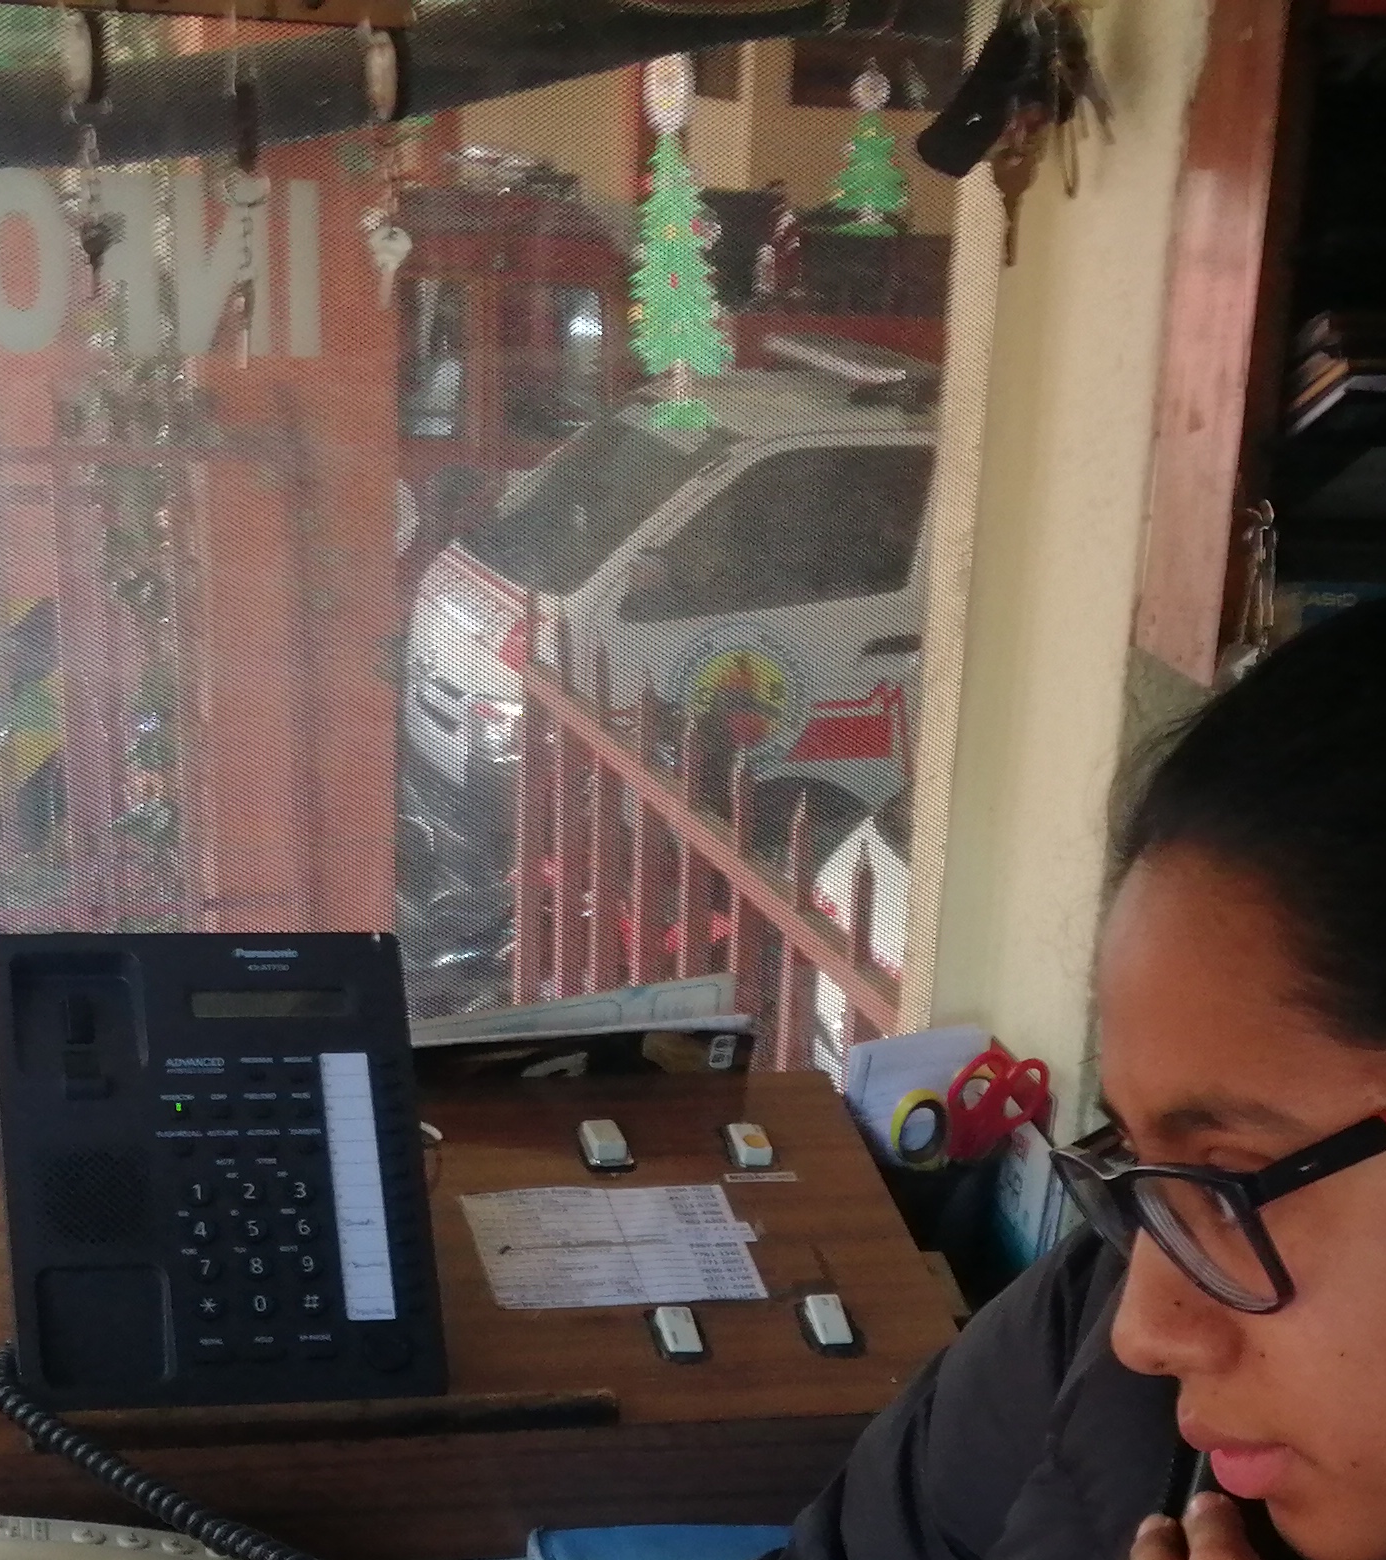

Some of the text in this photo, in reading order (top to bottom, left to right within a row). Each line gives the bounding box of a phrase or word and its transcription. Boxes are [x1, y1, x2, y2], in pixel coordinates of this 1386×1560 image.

[165, 1056, 225, 1069] ADVANCED
[192, 1181, 308, 1201] 1 2 3
[193, 1218, 311, 1239] 4 5 6
[199, 1255, 315, 1276] 7 8 9
[253, 1294, 268, 1313] 0
